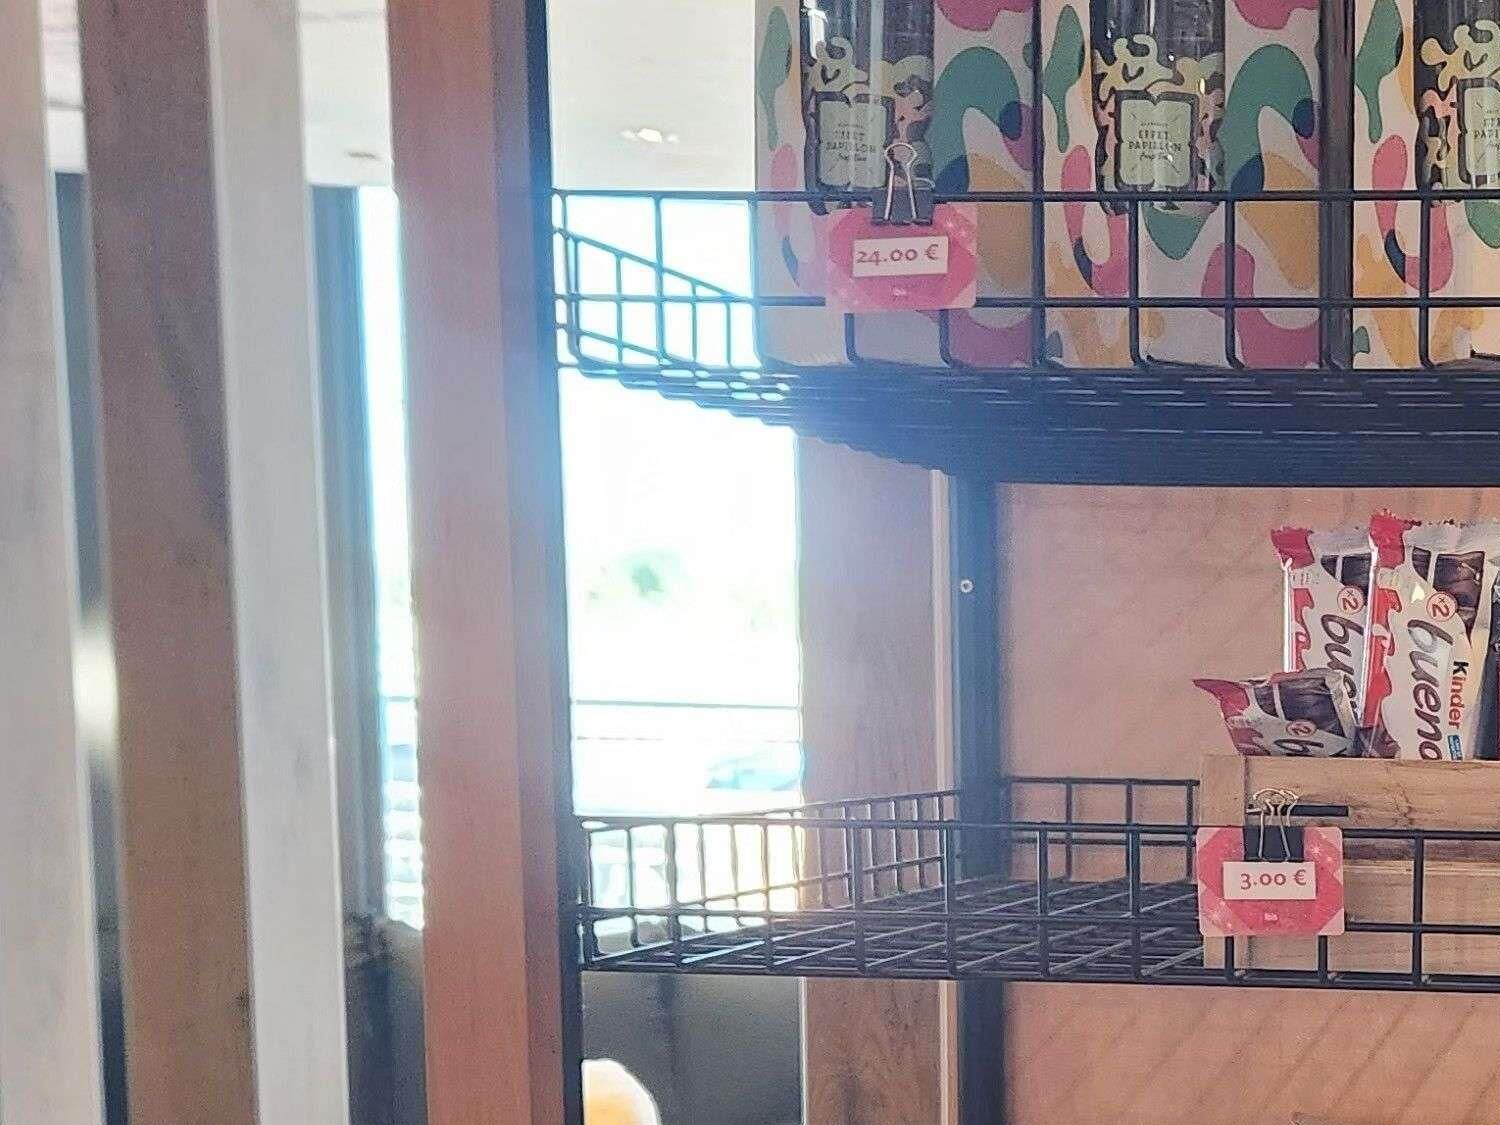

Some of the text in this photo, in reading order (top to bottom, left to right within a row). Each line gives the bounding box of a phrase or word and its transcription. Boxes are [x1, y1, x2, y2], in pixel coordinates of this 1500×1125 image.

[856, 243, 940, 266] 24.00 €
[1406, 618, 1454, 761] bueno
[1448, 660, 1470, 730] Kinder
[1240, 869, 1307, 890] 3.00 €
